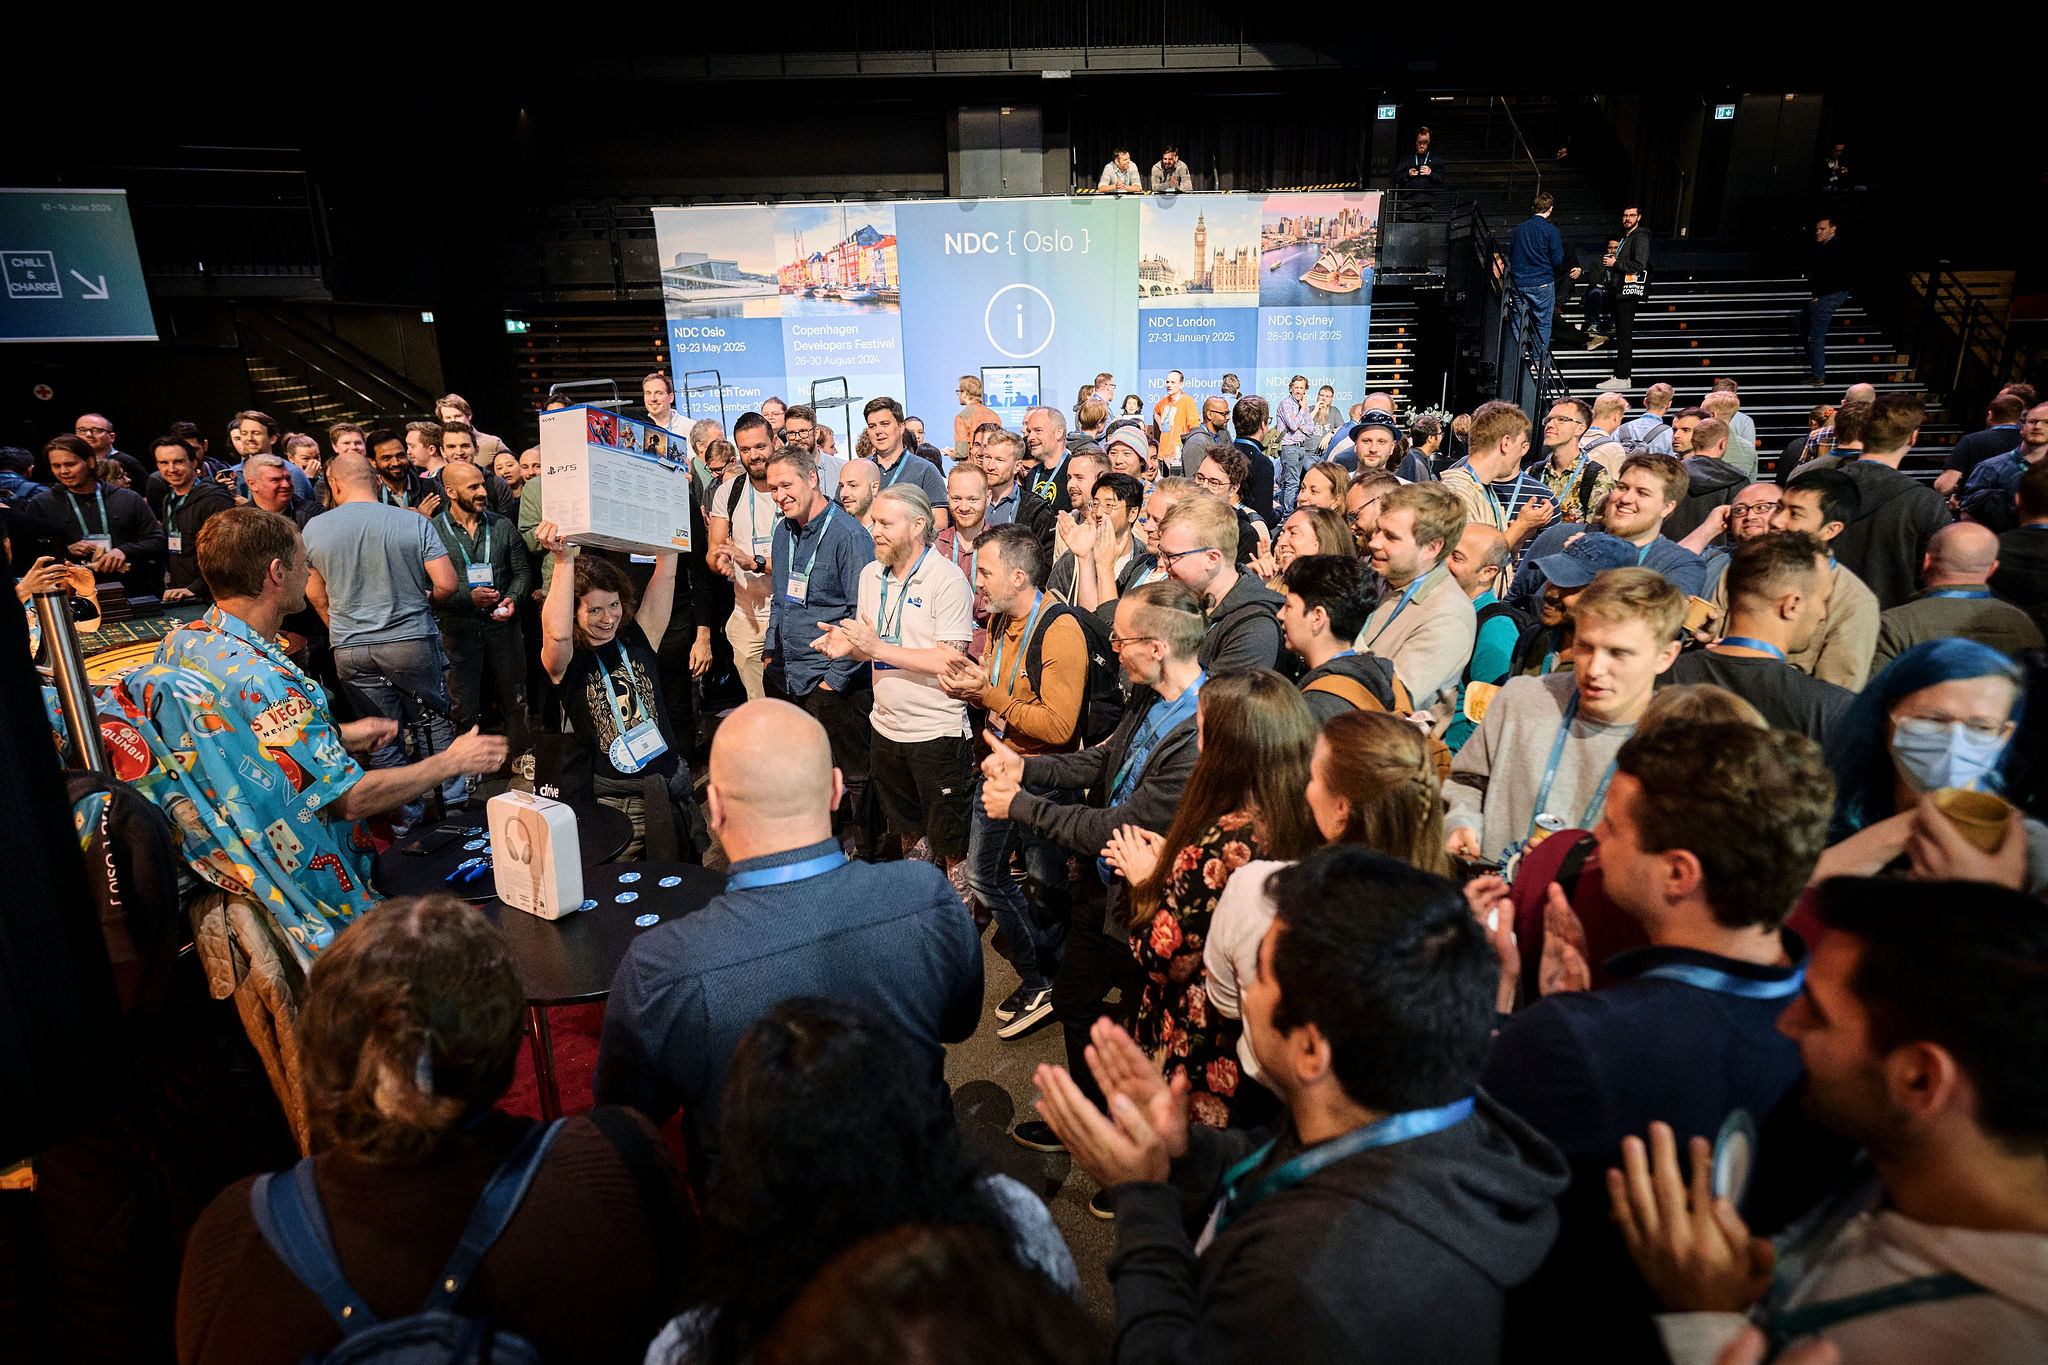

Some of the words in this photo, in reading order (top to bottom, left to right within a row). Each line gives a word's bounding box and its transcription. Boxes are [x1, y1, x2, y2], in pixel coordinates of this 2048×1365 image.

[69, 204, 90, 212] June
[944, 231, 1000, 255] NDC
[1023, 228, 1074, 253] Oslo
[12, 258, 46, 267] CHILL
[27, 270, 36, 280] &
[10, 282, 58, 292] CHARGE
[1149, 316, 1174, 327] NDC
[1176, 316, 1216, 327] London
[1268, 315, 1292, 326] NDC
[1294, 314, 1334, 328] Sydney
[674, 327, 699, 338] NDC
[701, 326, 726, 338] Oslo
[792, 324, 858, 338] Copenhagen
[1267, 332, 1294, 341] 28-30
[1296, 331, 1317, 342] April
[1319, 330, 1342, 340] 2025
[1148, 333, 1172, 342] 27-31
[1174, 332, 1210, 344] January
[1212, 332, 1235, 342] 2025
[676, 342, 700, 352] 19-23
[702, 343, 721, 354] May
[722, 342, 746, 352] 2025
[794, 340, 852, 352] Developers
[854, 338, 894, 350] Festival
[795, 356, 822, 366] 26-30
[824, 355, 856, 368] August
[858, 354, 880, 364] 2024
[1148, 378, 1167, 389] ND
[709, 386, 760, 398] TechTown
[1148, 394, 1160, 404] 30
[702, 402, 752, 414] Sepember
[557, 464, 578, 473] PS5
[268, 699, 312, 725] VEGAS
[101, 727, 145, 763] OLUMBIA
[540, 784, 560, 798] drive
